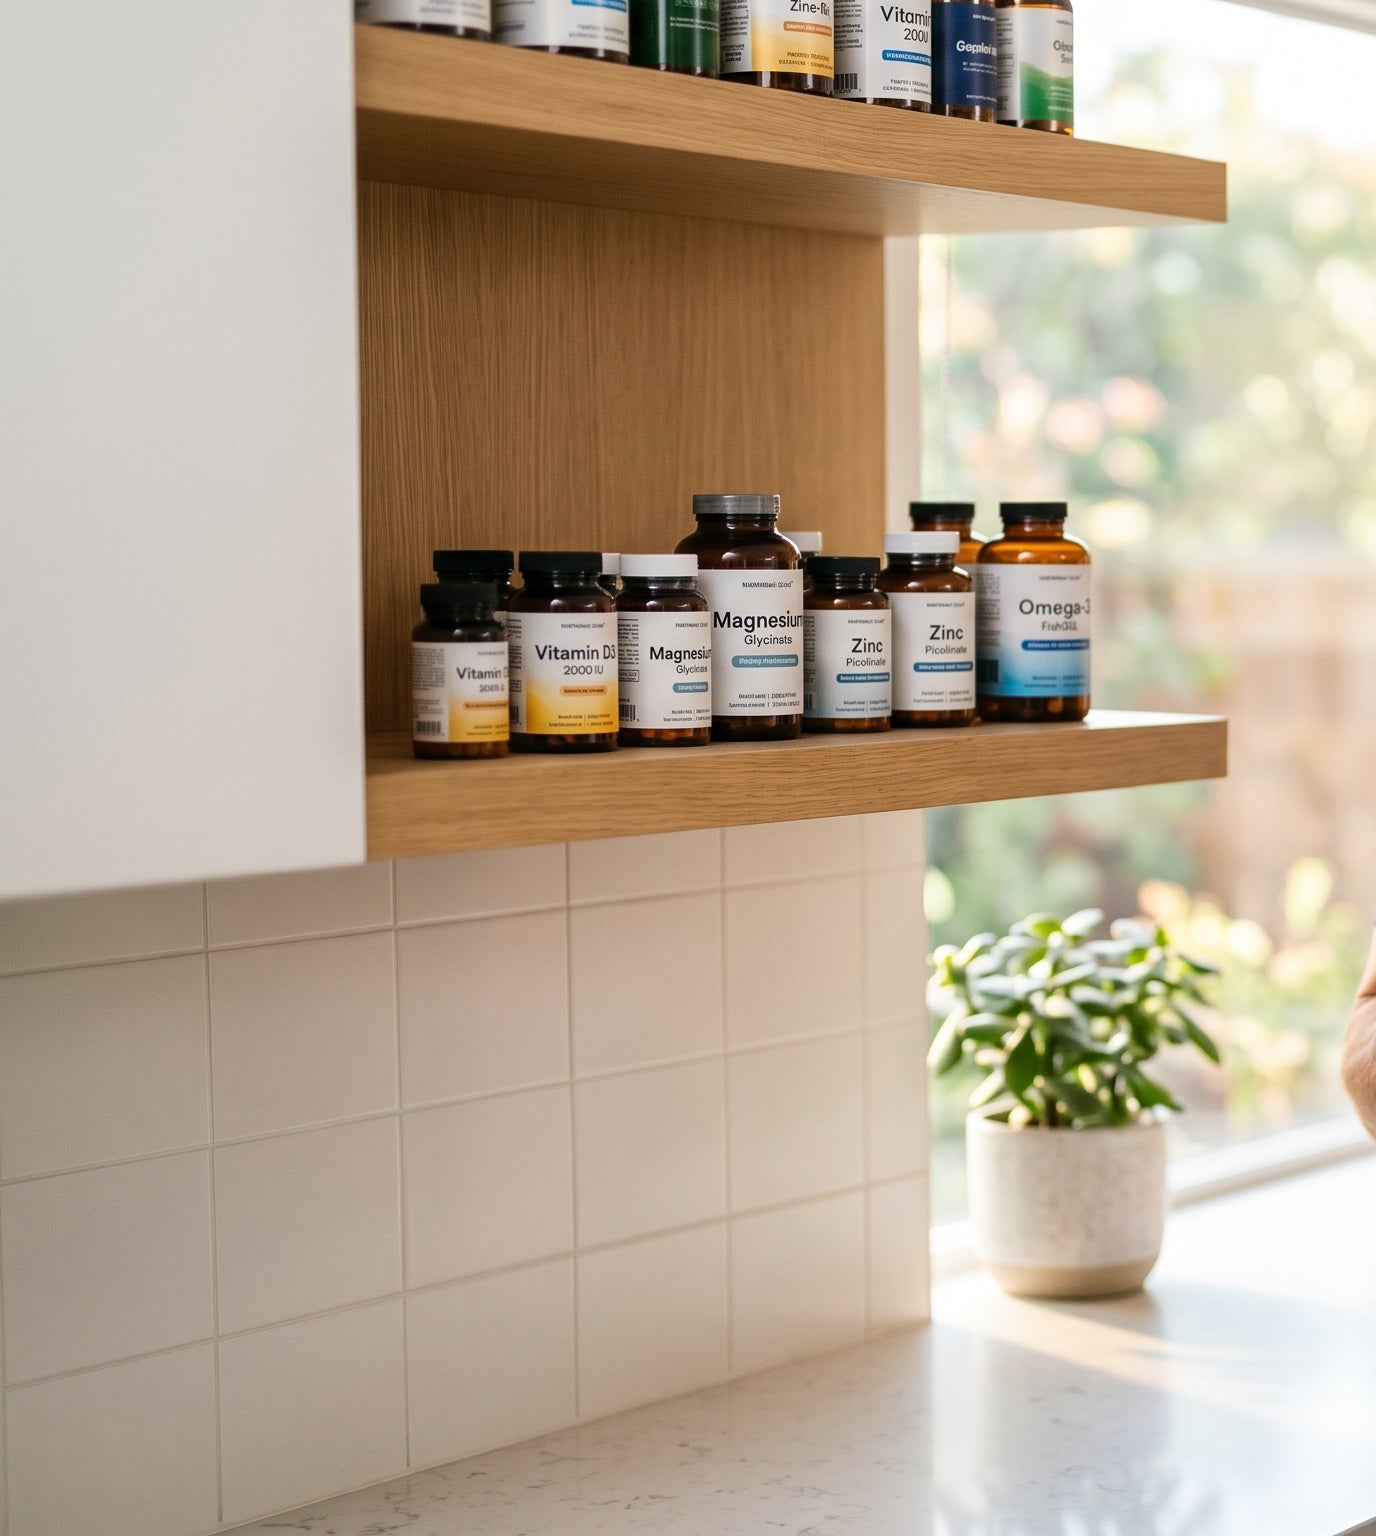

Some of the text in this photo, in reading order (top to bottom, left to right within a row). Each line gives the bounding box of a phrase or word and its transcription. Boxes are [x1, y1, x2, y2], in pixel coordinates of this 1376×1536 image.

[930, 625, 964, 640] Zinc
[535, 645, 616, 660] Vitamin D3
[852, 638, 883, 653] Zinc
[456, 667, 502, 679] Vitamin
[563, 665, 604, 675] 2000 IU
